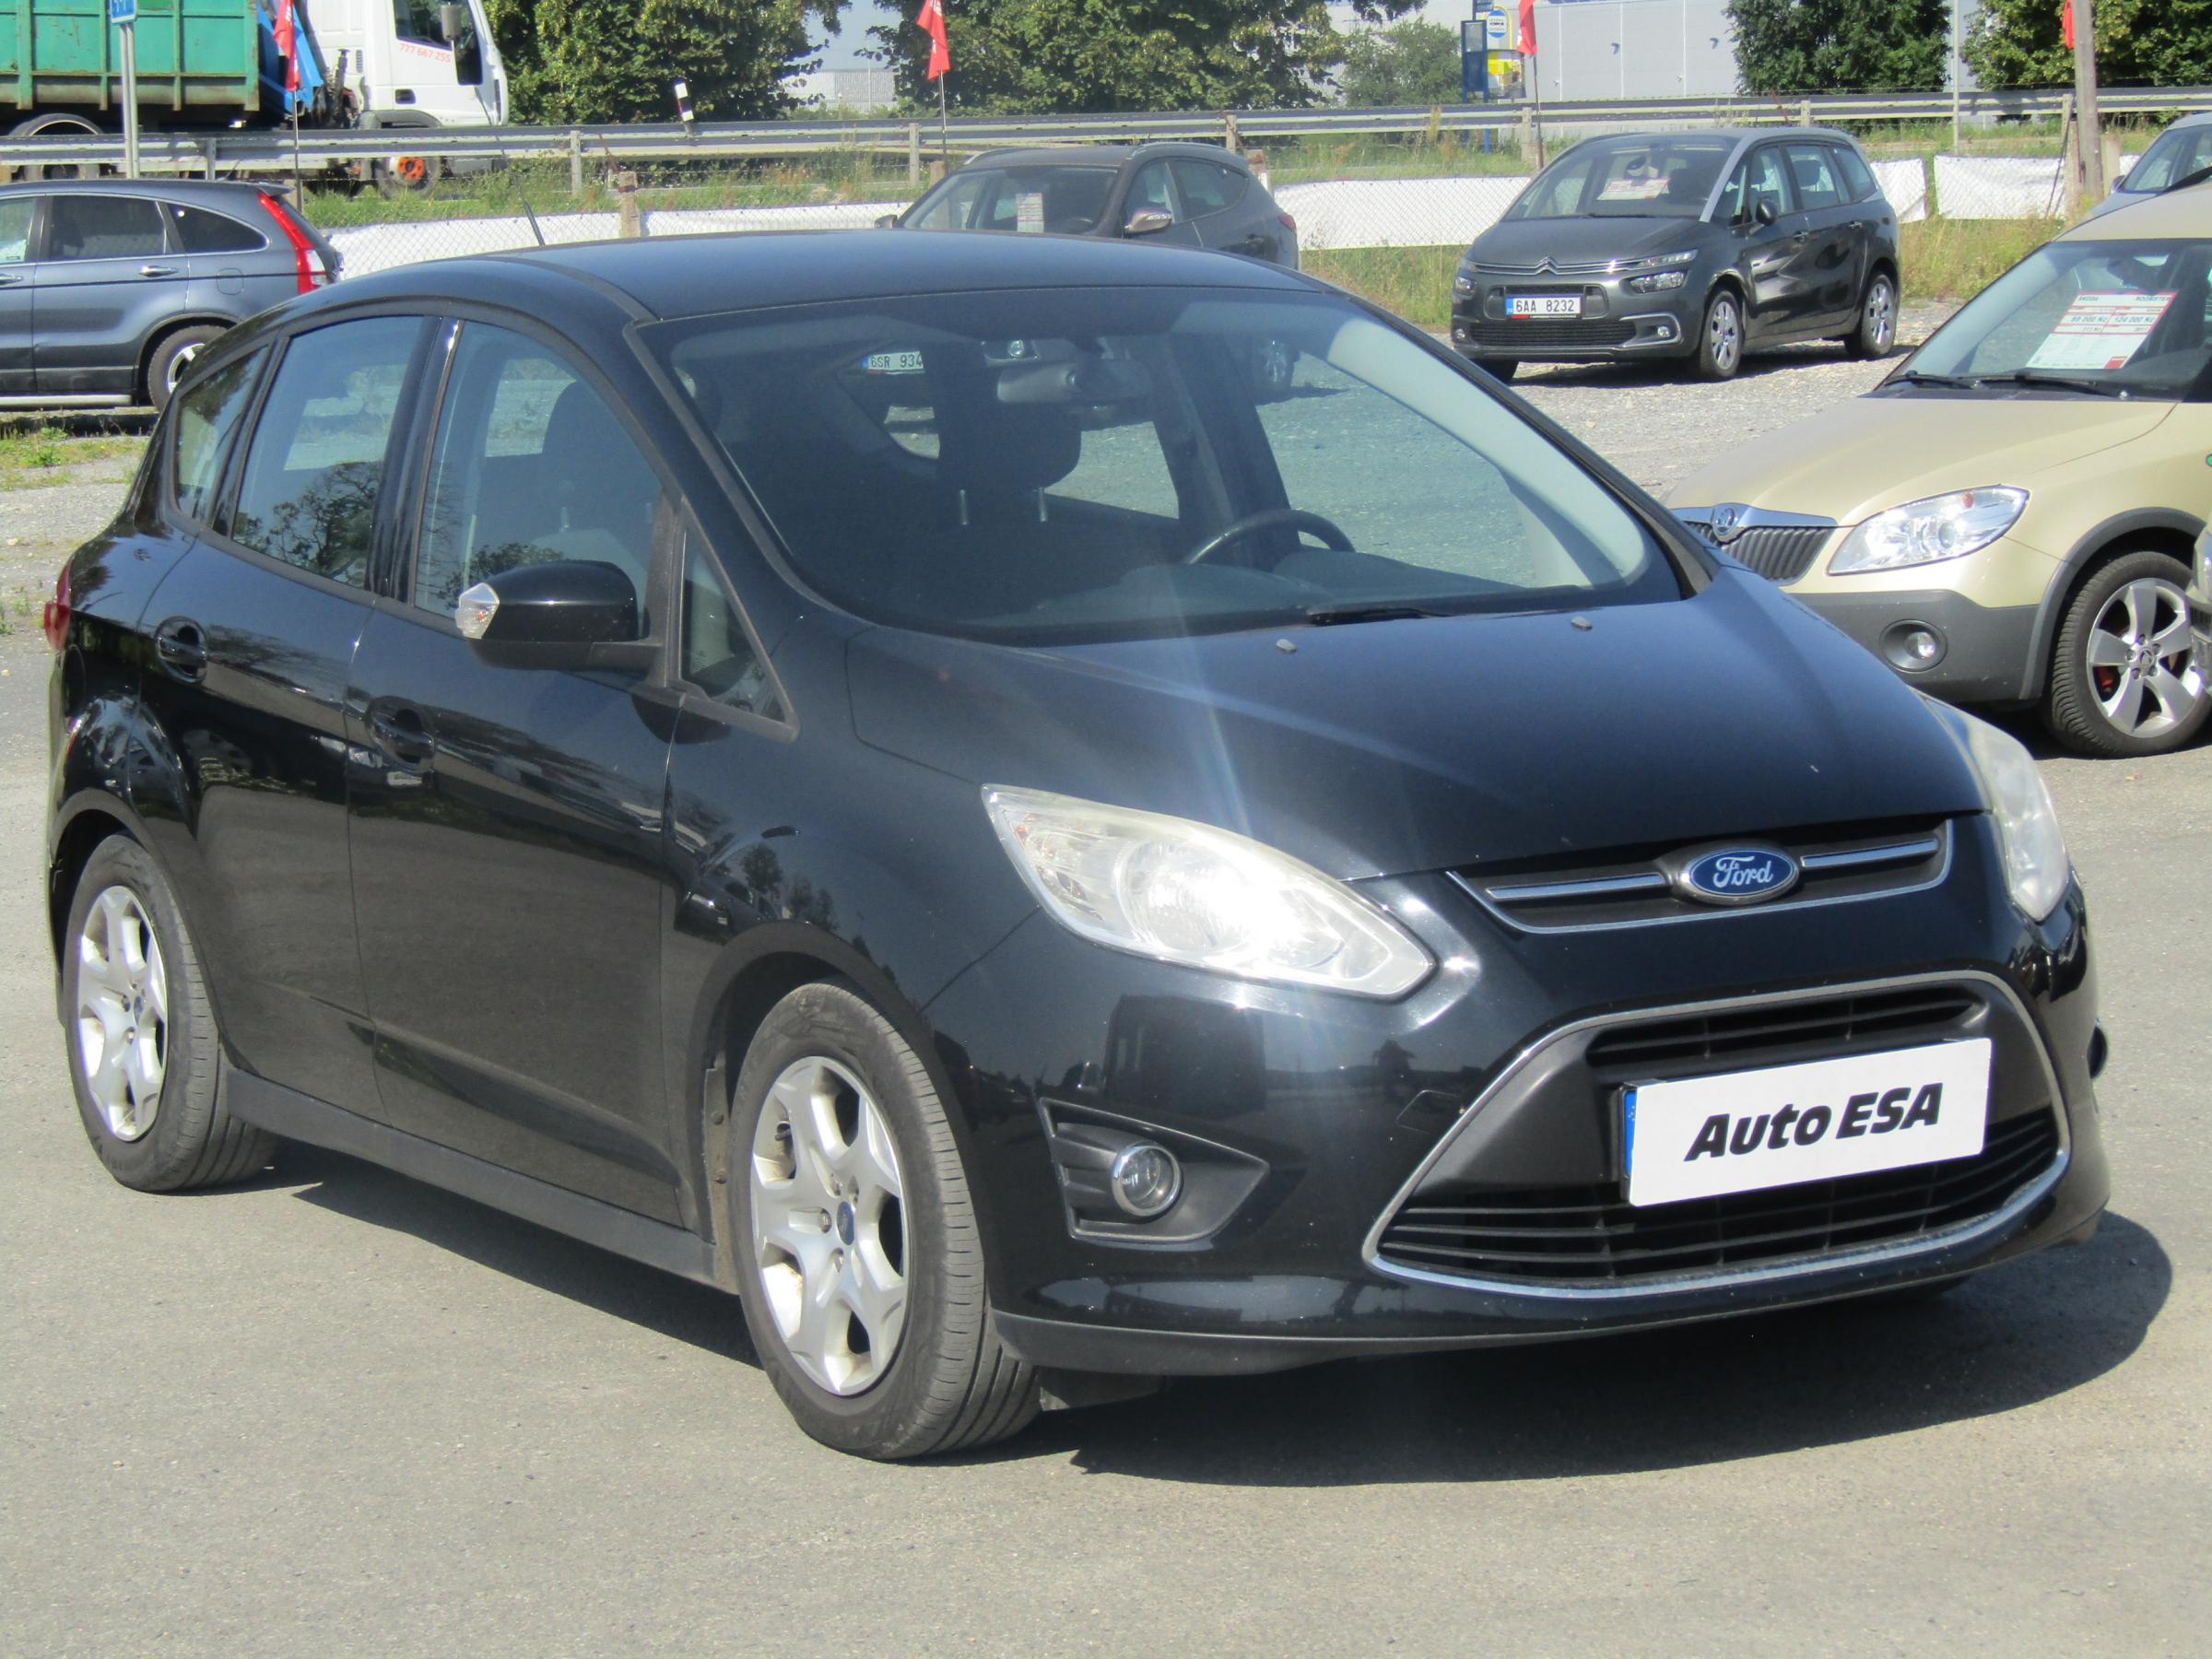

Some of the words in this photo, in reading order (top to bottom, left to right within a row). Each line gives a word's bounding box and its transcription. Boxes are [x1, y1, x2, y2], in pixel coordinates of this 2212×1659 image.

[1515, 300, 1536, 312] 6AA
[1546, 300, 1575, 312] 8232
[870, 355, 890, 369] 6SR
[1713, 856, 1774, 888] Ford
[1683, 1103, 1832, 1162] Auto
[1835, 1082, 1944, 1139] ESA
